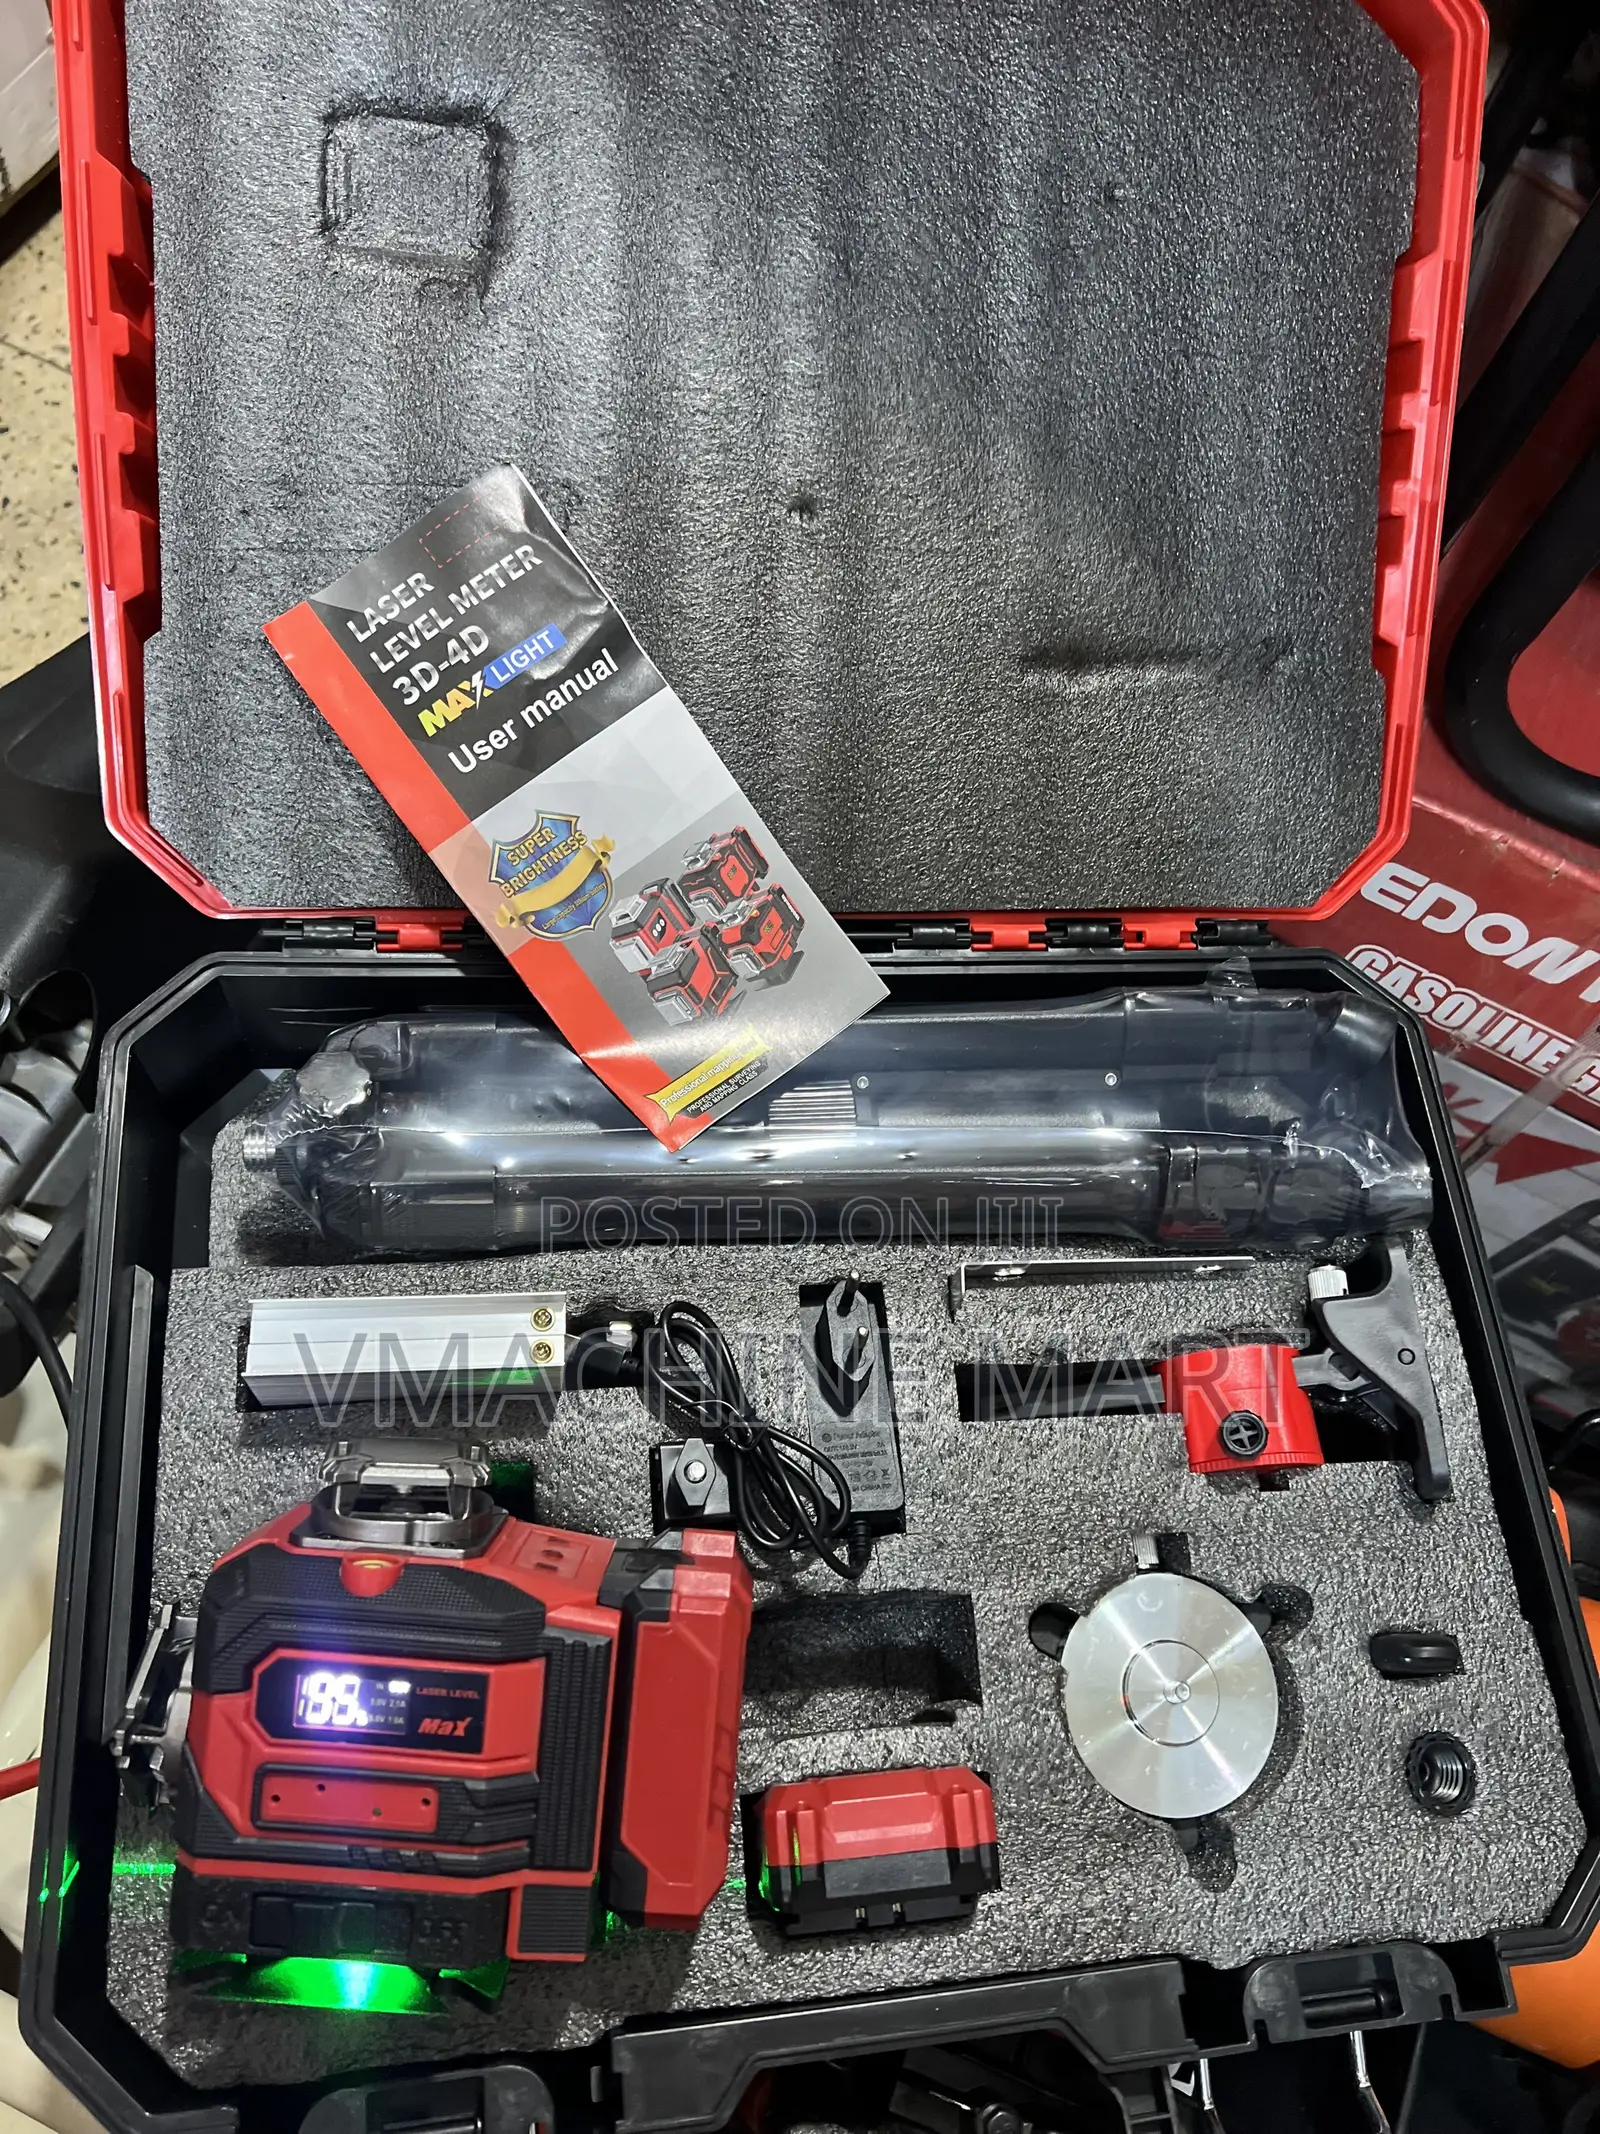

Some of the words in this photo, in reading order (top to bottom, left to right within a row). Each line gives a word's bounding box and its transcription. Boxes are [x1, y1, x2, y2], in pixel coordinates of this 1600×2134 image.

[346, 572, 435, 643] LASER
[369, 607, 454, 673] LEVEL
[448, 545, 543, 615] METER
[392, 625, 490, 706] 3D-4D
[490, 630, 557, 683] LIGHT
[448, 718, 519, 774] User
[519, 647, 620, 729] manual
[500, 830, 588, 898] BRIGHTNESS
[507, 827, 557, 866] SUPER
[1361, 862, 1600, 985] EDON
[1352, 949, 1572, 1075] GASOLINE
[660, 1072, 709, 1108] Professional
[706, 1051, 744, 1078] mapping
[686, 1082, 731, 1113] PROFESSIONAL
[728, 1060, 762, 1086] SURVEYING
[700, 1101, 713, 1113] AND
[711, 1085, 739, 1104] MAPPING
[738, 1070, 759, 1086] CLASS
[416, 1688, 447, 1697] LASER
[450, 1689, 480, 1698] LEVEL
